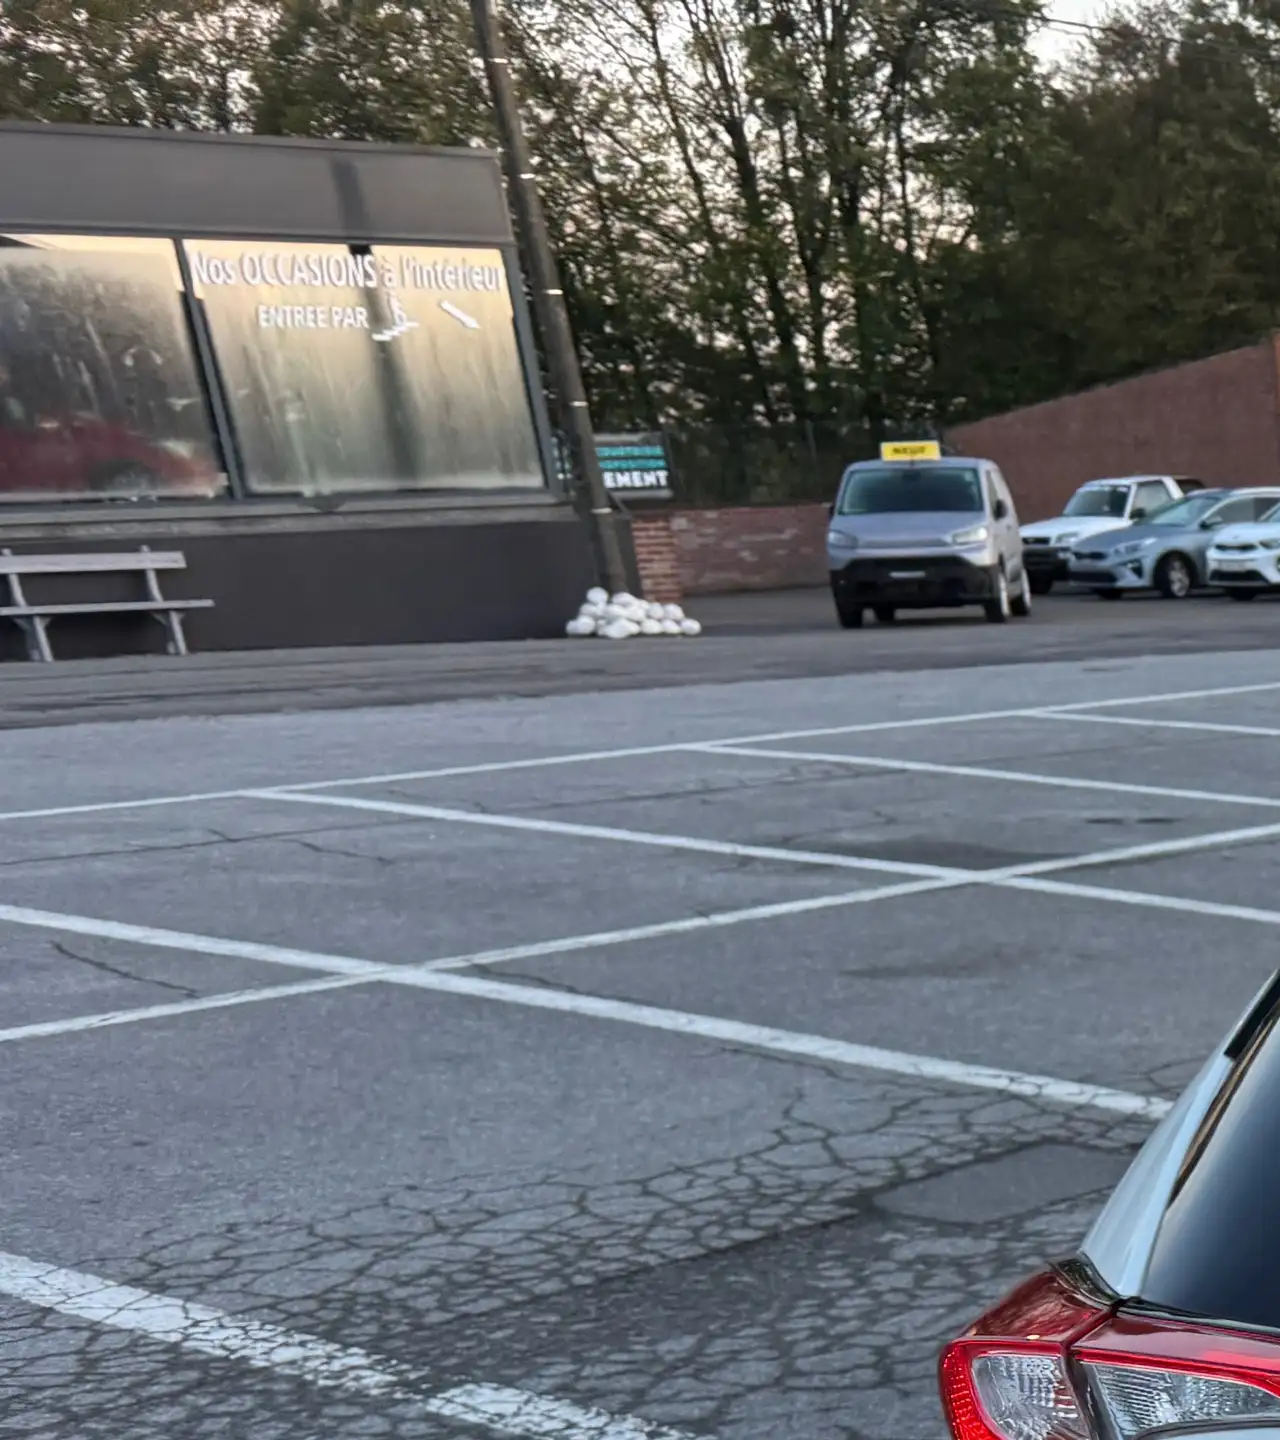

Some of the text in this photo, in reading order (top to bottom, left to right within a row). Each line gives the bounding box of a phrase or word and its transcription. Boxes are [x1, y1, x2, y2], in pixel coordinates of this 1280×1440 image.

[191, 252, 235, 285] Nos
[241, 252, 377, 288] OCCASIONS
[331, 305, 369, 329] PAR
[603, 471, 668, 488] EMENT
